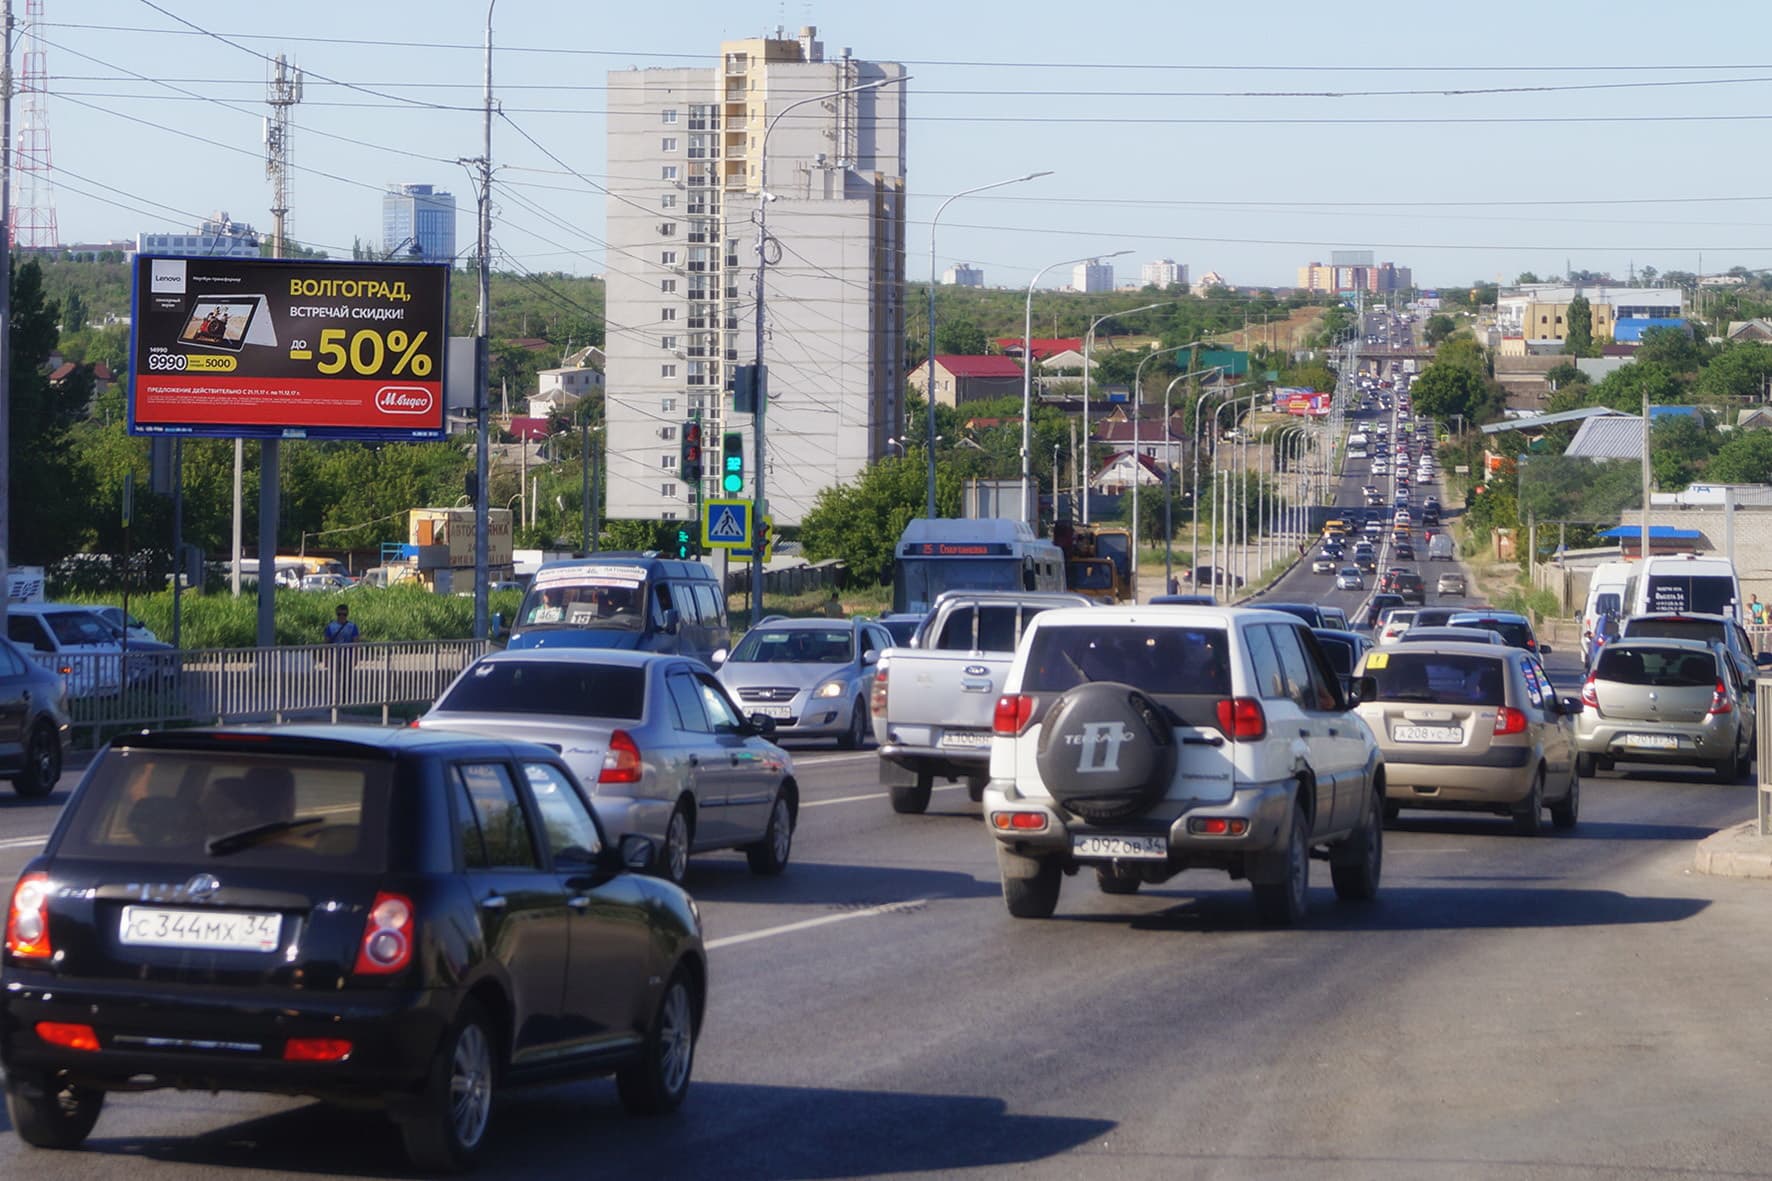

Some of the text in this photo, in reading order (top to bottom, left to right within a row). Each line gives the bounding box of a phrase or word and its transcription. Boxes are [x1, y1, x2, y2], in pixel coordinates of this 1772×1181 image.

[290, 279, 412, 302] ВОЛГОГРАД,
[289, 306, 405, 320] ВСТРЕЧАЙ СКИДКИ!
[289, 328, 433, 377] -50%
[290, 339, 308, 350] ДО
[149, 354, 187, 371] 9990
[205, 358, 231, 369] 5000
[244, 916, 270, 935] 34
